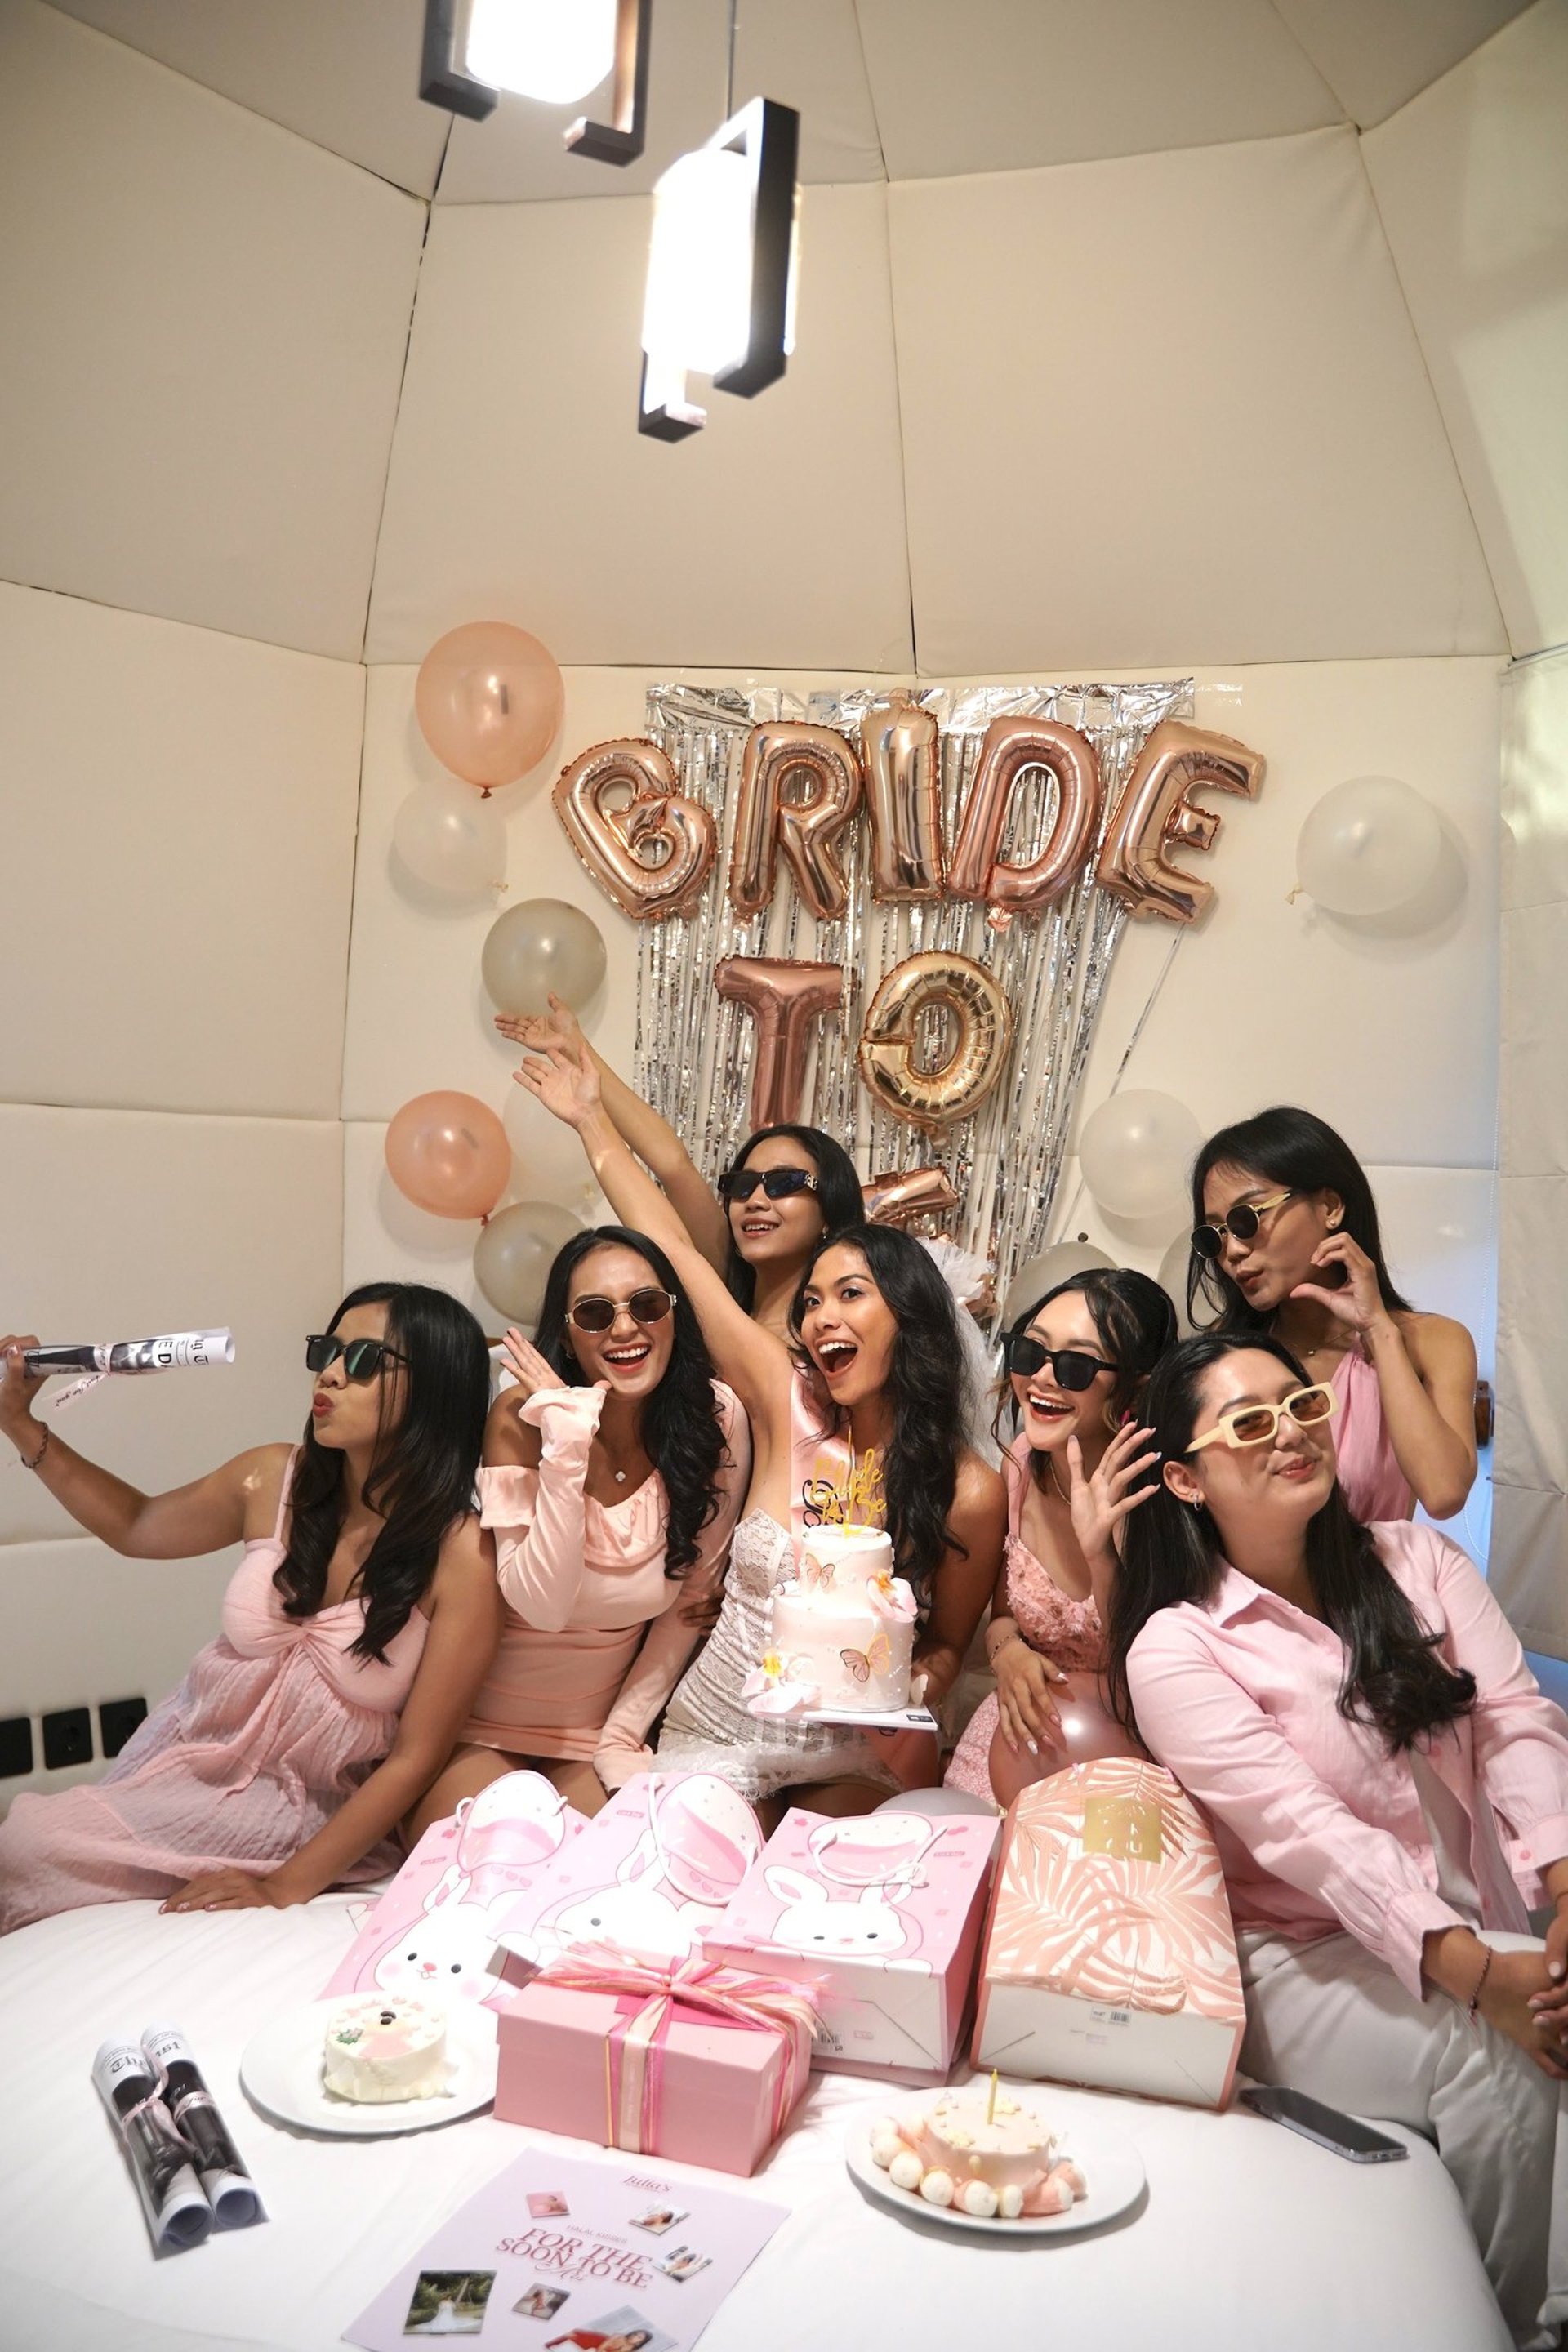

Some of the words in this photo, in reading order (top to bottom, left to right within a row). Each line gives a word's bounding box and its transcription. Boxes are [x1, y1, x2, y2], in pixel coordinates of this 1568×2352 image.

[551, 692, 1266, 924] BRIDE
[715, 950, 1013, 1135] TO
[496, 2238, 572, 2267] SOON
[579, 2256, 611, 2277] TO
[614, 2267, 653, 2288] BE
[520, 2228, 583, 2254] FOR
[586, 2243, 653, 2271] THE
